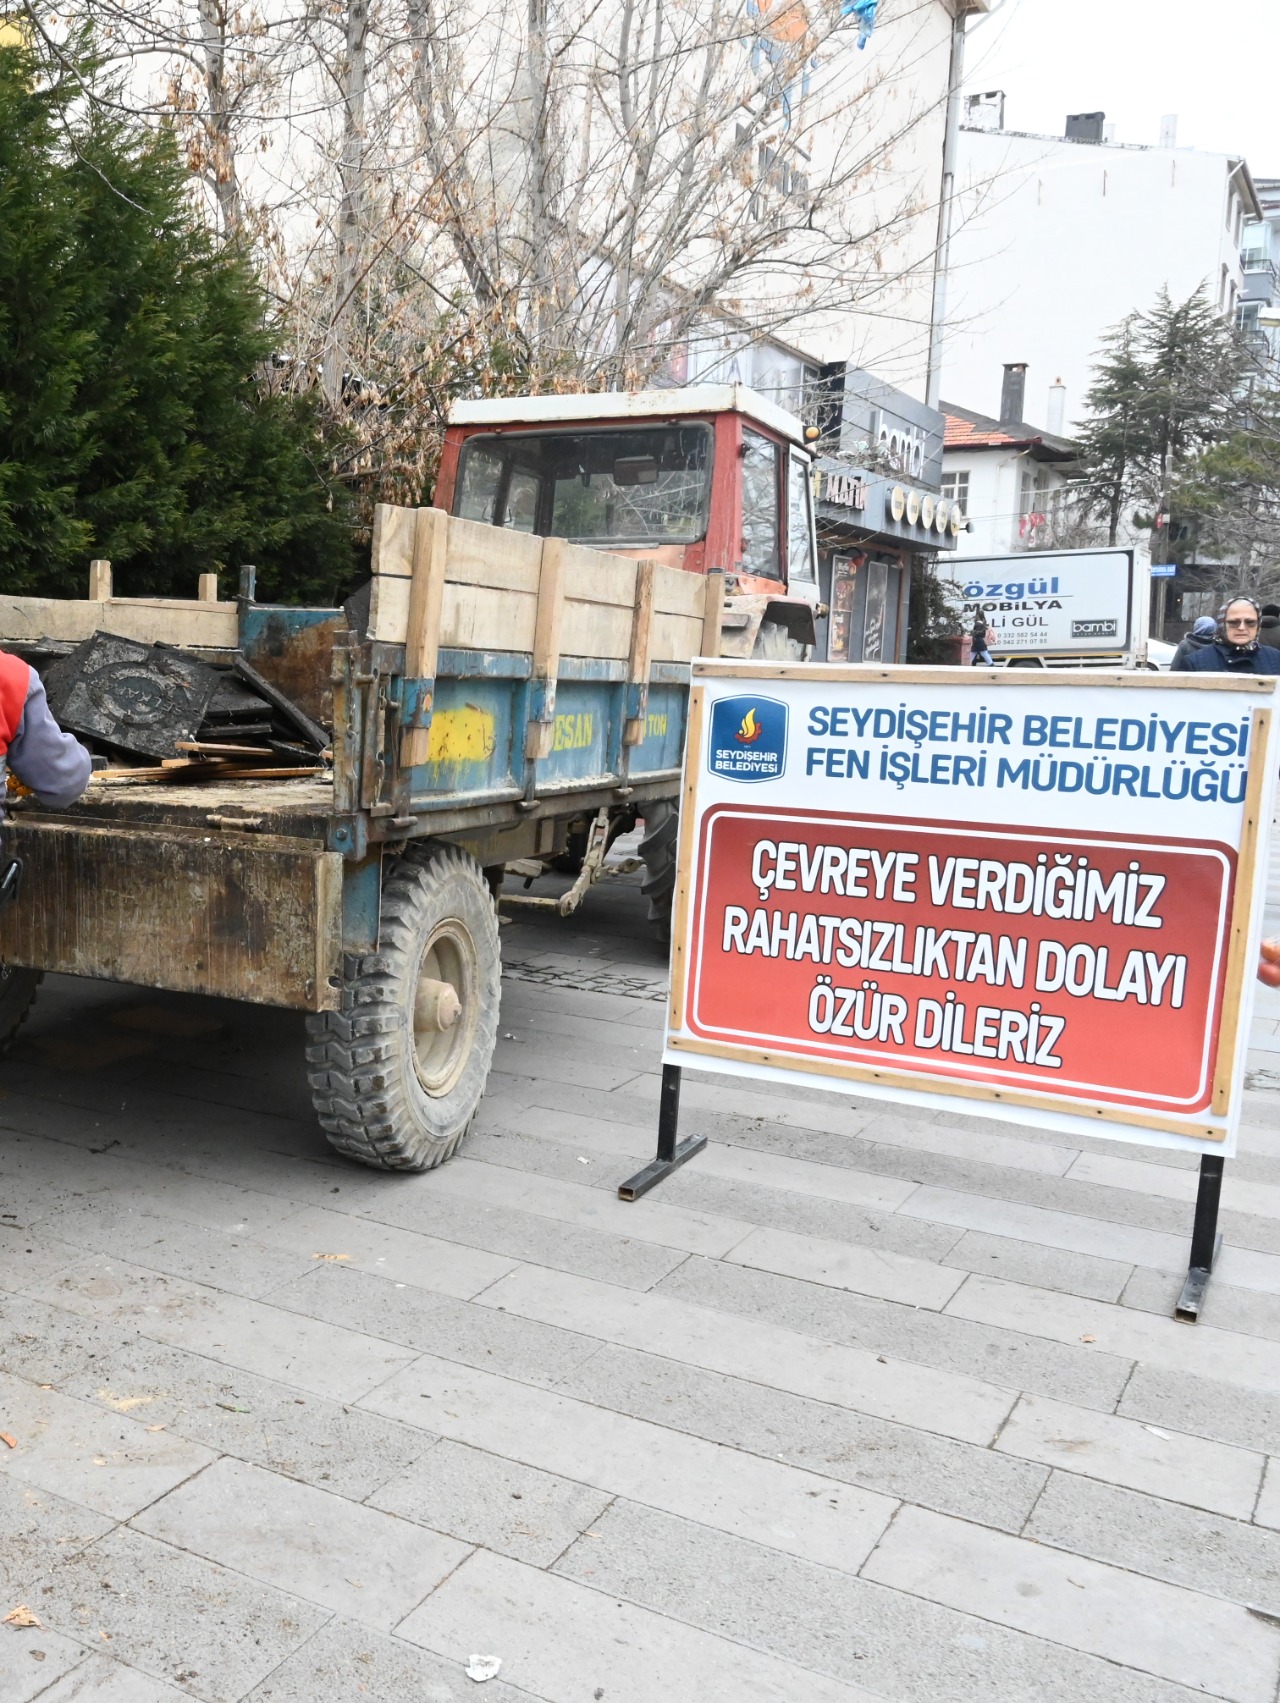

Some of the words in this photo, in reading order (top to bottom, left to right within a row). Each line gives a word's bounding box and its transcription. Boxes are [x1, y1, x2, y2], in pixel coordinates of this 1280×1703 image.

[964, 576, 1059, 600] özgül
[1011, 614, 1049, 628] GÜL
[1072, 620, 1117, 632] bambi
[551, 712, 593, 752] ESAN
[807, 702, 1014, 749] SEYDİŞEHİR
[1022, 712, 1251, 758] BELEDİYESİ
[805, 747, 870, 780] FEN
[879, 744, 988, 790] İŞLERİ
[996, 752, 1248, 805] MÜDÜRLÜĞÜ
[751, 839, 920, 901] ÇEVREYE
[927, 852, 1167, 929] VERDİĞİMİZ
[721, 905, 1028, 989] RAHATSIZLIKTAN
[1034, 939, 1189, 1009] DOLAYI
[806, 974, 909, 1045] ÖZÜR
[913, 991, 1066, 1069] DİLERİZ
